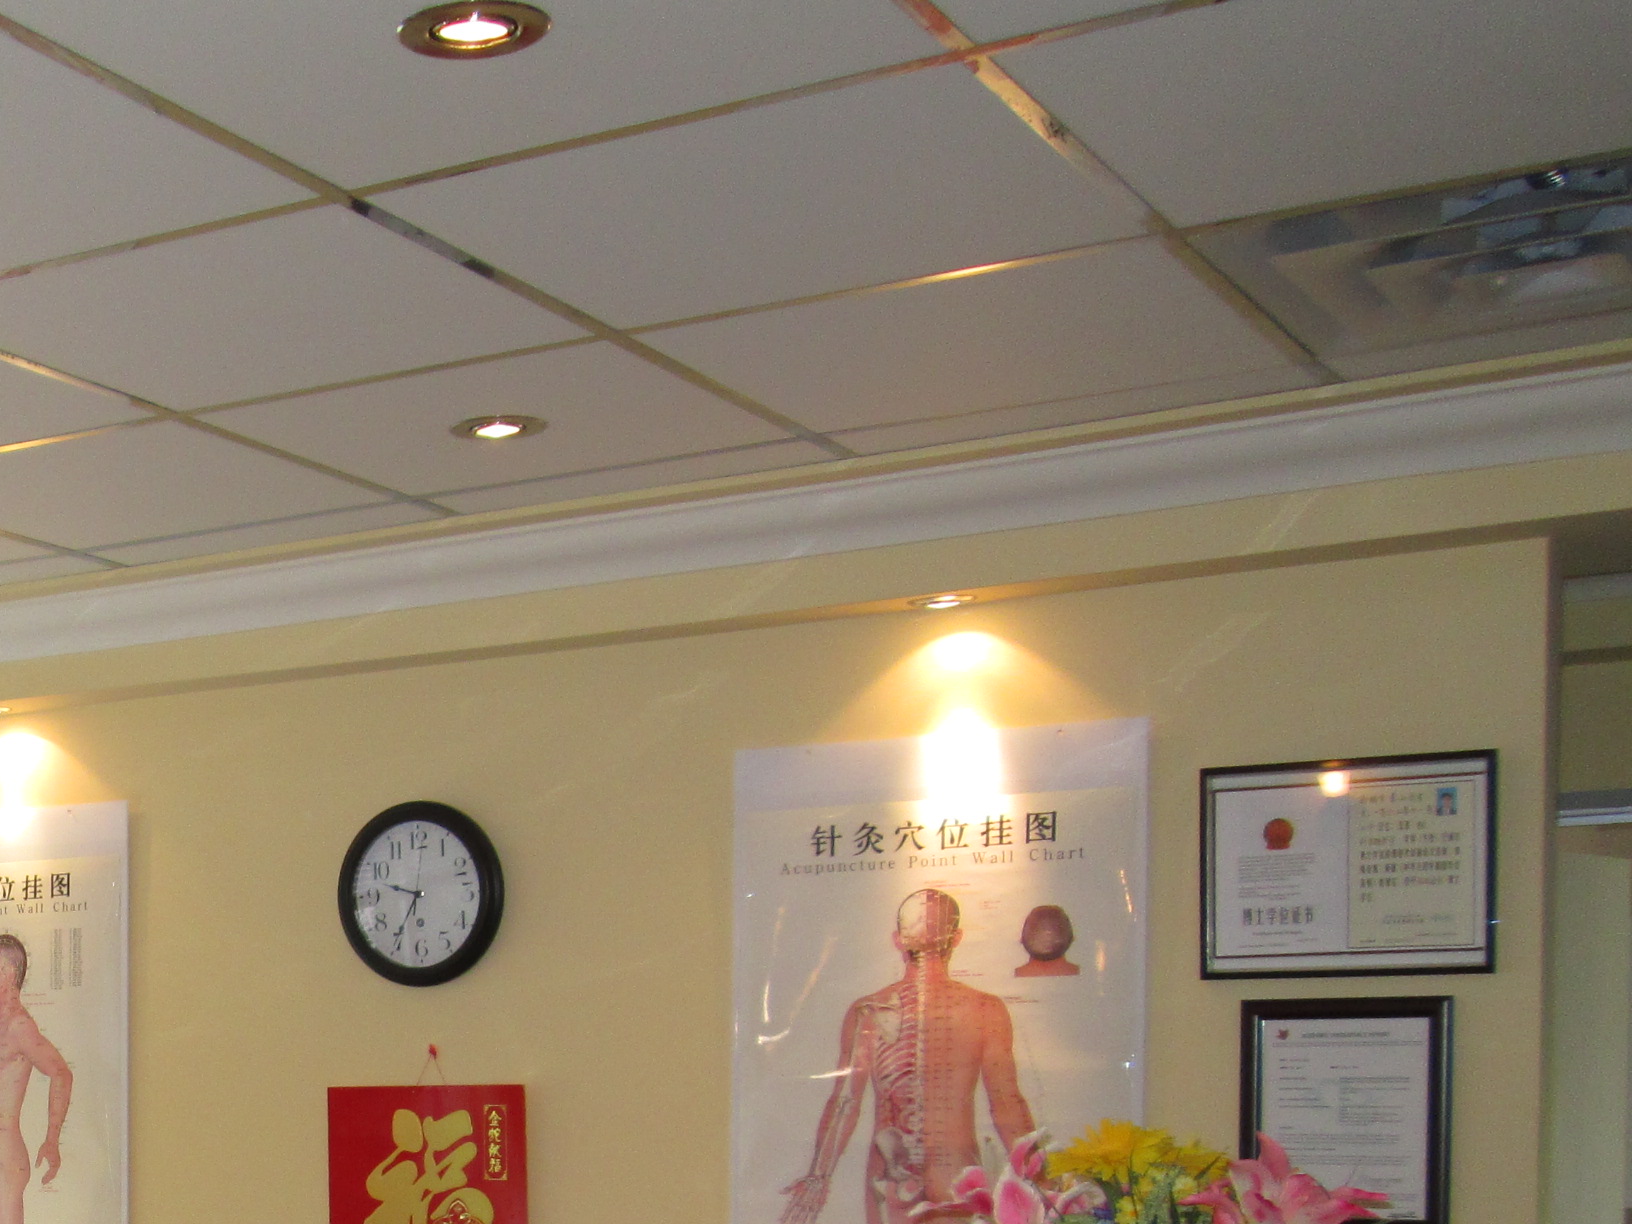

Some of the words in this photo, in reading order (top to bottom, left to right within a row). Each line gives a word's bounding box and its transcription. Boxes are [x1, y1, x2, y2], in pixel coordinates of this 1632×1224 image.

[410, 830, 428, 850] 12
[810, 811, 1058, 857] 针灸穴位挂图
[389, 840, 402, 860] 11
[373, 861, 390, 880] 10
[454, 856, 467, 876] 2
[780, 857, 897, 876] Acupuncture
[908, 854, 957, 868] Point
[972, 849, 1014, 864] Wall
[1029, 846, 1085, 862] Chart
[367, 887, 380, 906] 9
[17, 903, 44, 914] Wall
[53, 900, 88, 912] Chart
[375, 912, 388, 932] 8
[454, 910, 468, 930] 4
[415, 939, 428, 958] 6
[439, 931, 451, 950] 5
